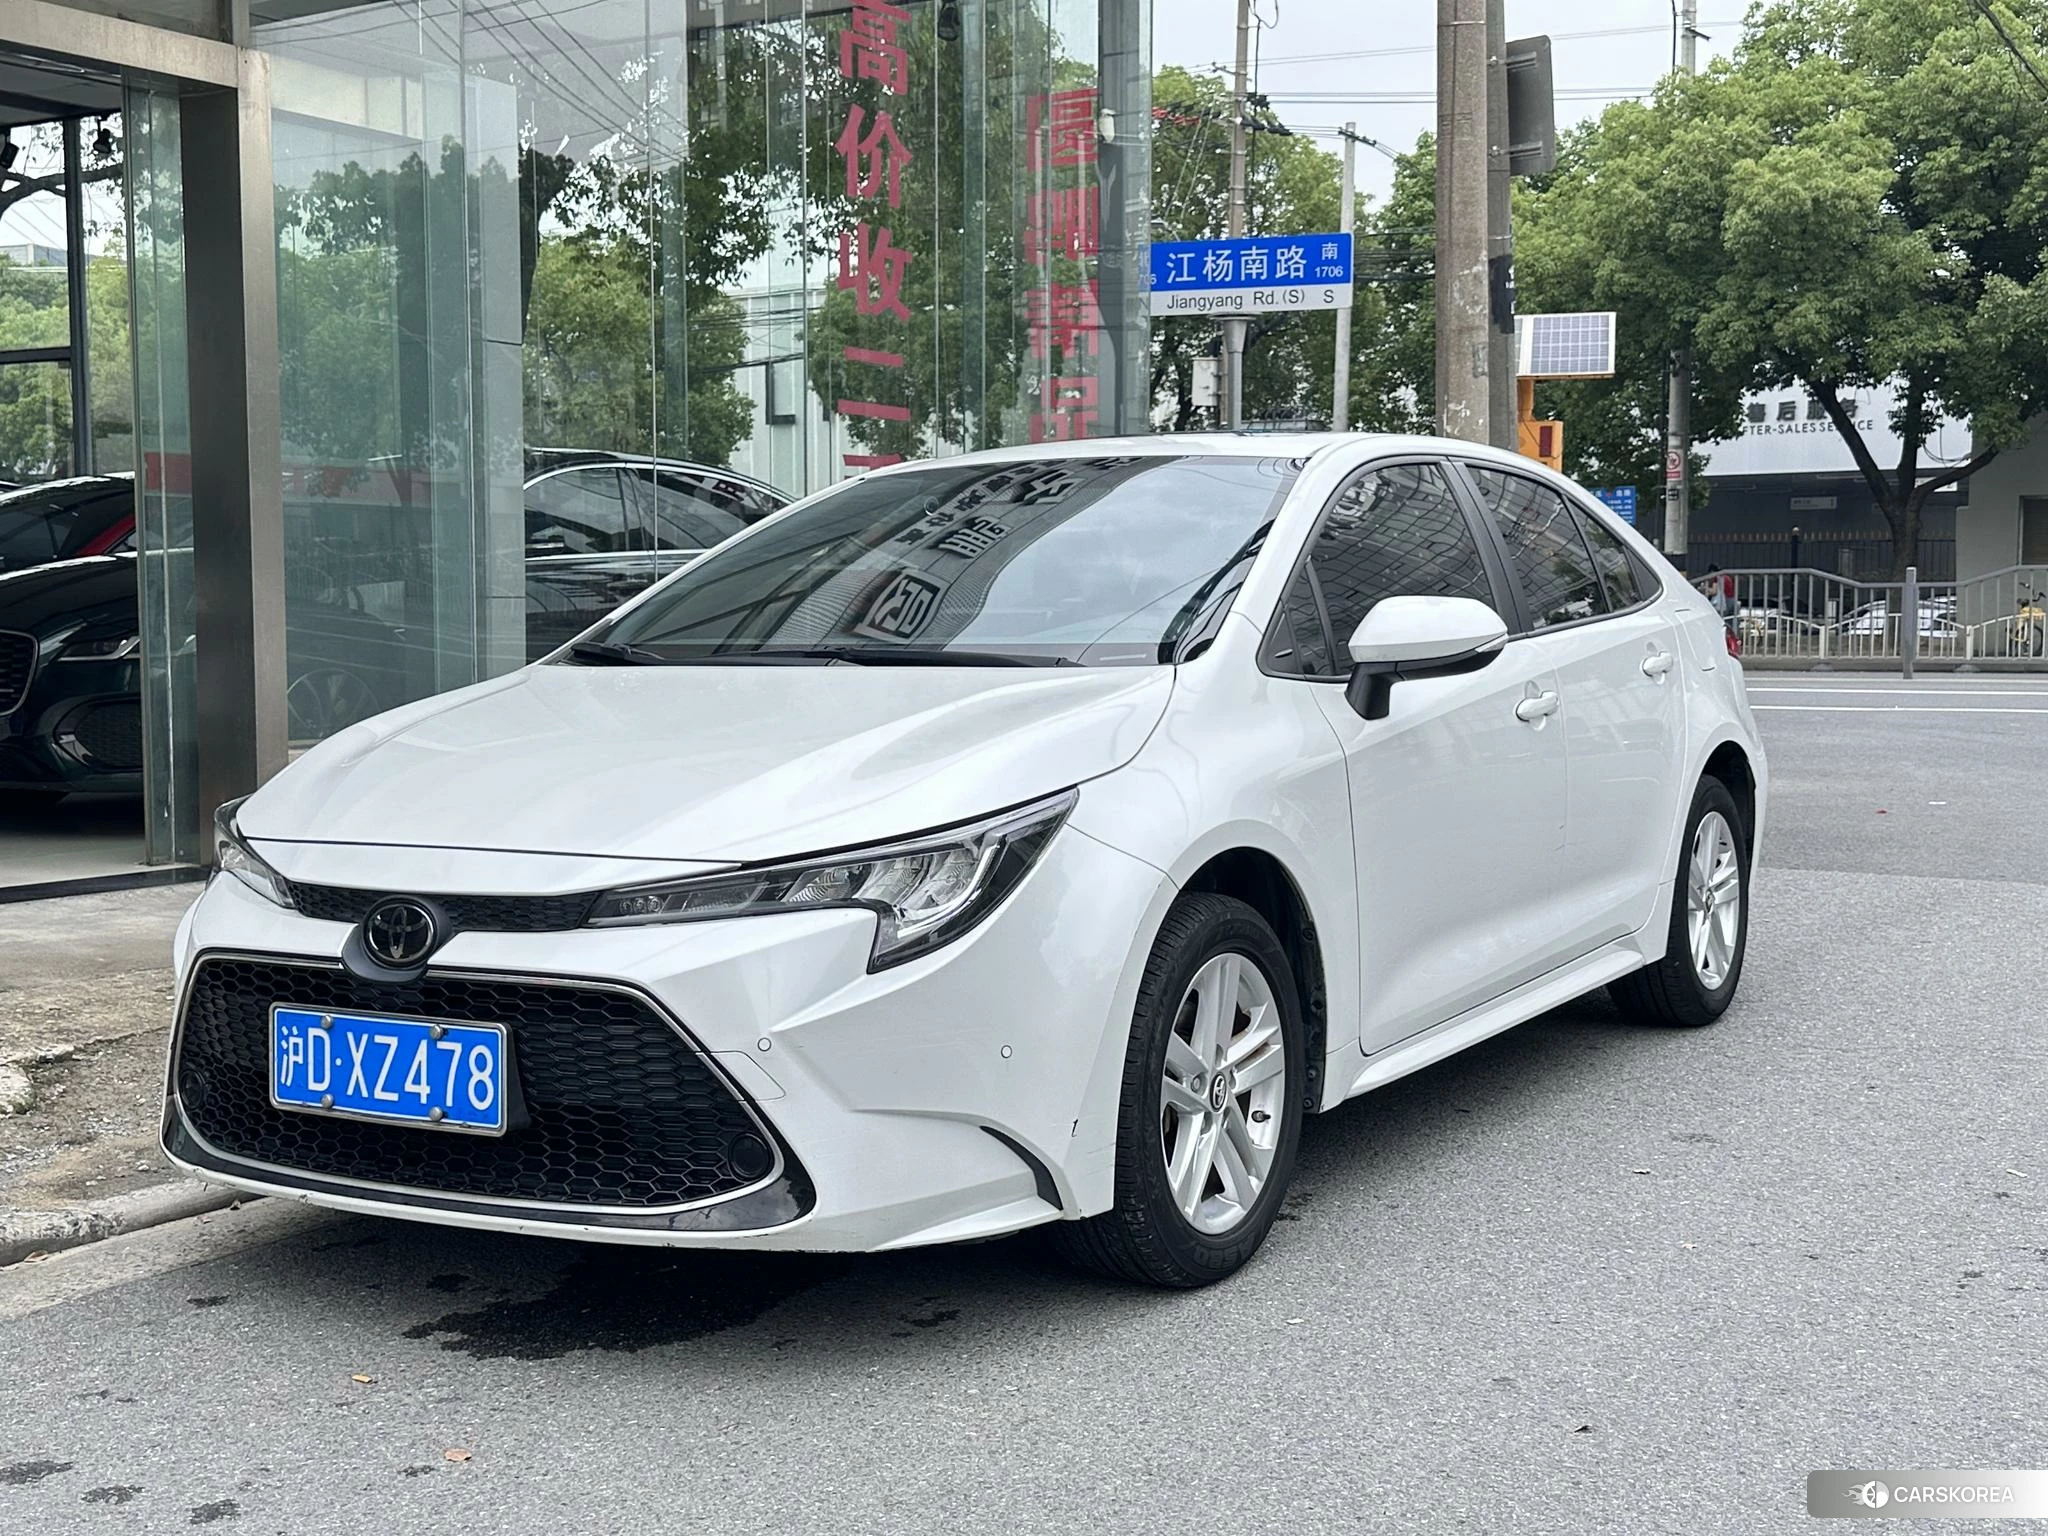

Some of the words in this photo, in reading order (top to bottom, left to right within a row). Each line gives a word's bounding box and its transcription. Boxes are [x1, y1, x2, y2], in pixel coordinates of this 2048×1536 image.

[1166, 245, 1307, 284] 江杨南路
[1321, 242, 1338, 261] 南
[1314, 265, 1344, 279] 1706
[1166, 293, 1243, 311] Jiangyang
[1323, 289, 1334, 304] S
[1742, 422, 1816, 436] FTER-SALES
[280, 1025, 495, 1111] 沪D·XZ478
